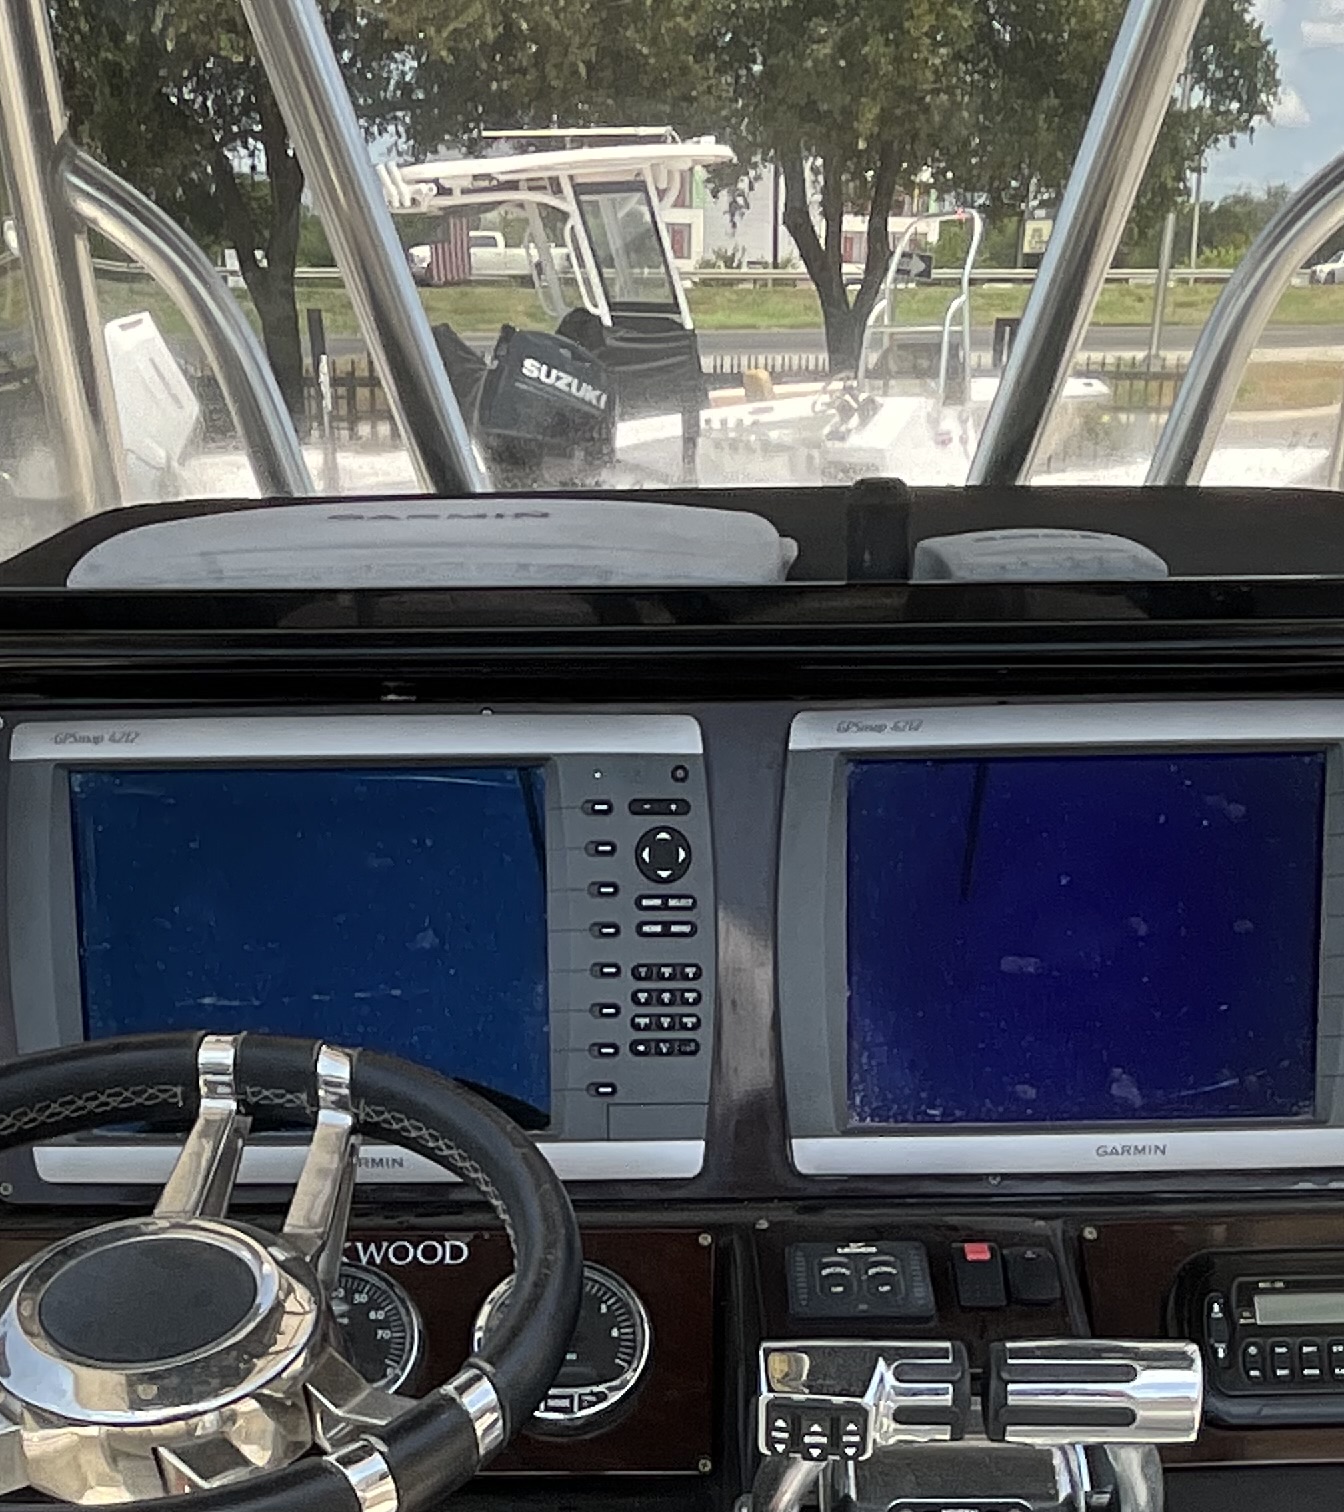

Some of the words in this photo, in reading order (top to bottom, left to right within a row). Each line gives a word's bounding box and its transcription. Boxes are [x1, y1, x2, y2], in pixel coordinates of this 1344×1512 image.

[521, 357, 607, 410] SUZUKI
[1095, 1143, 1168, 1158] GARMIN
[357, 1156, 404, 1169] RMIN
